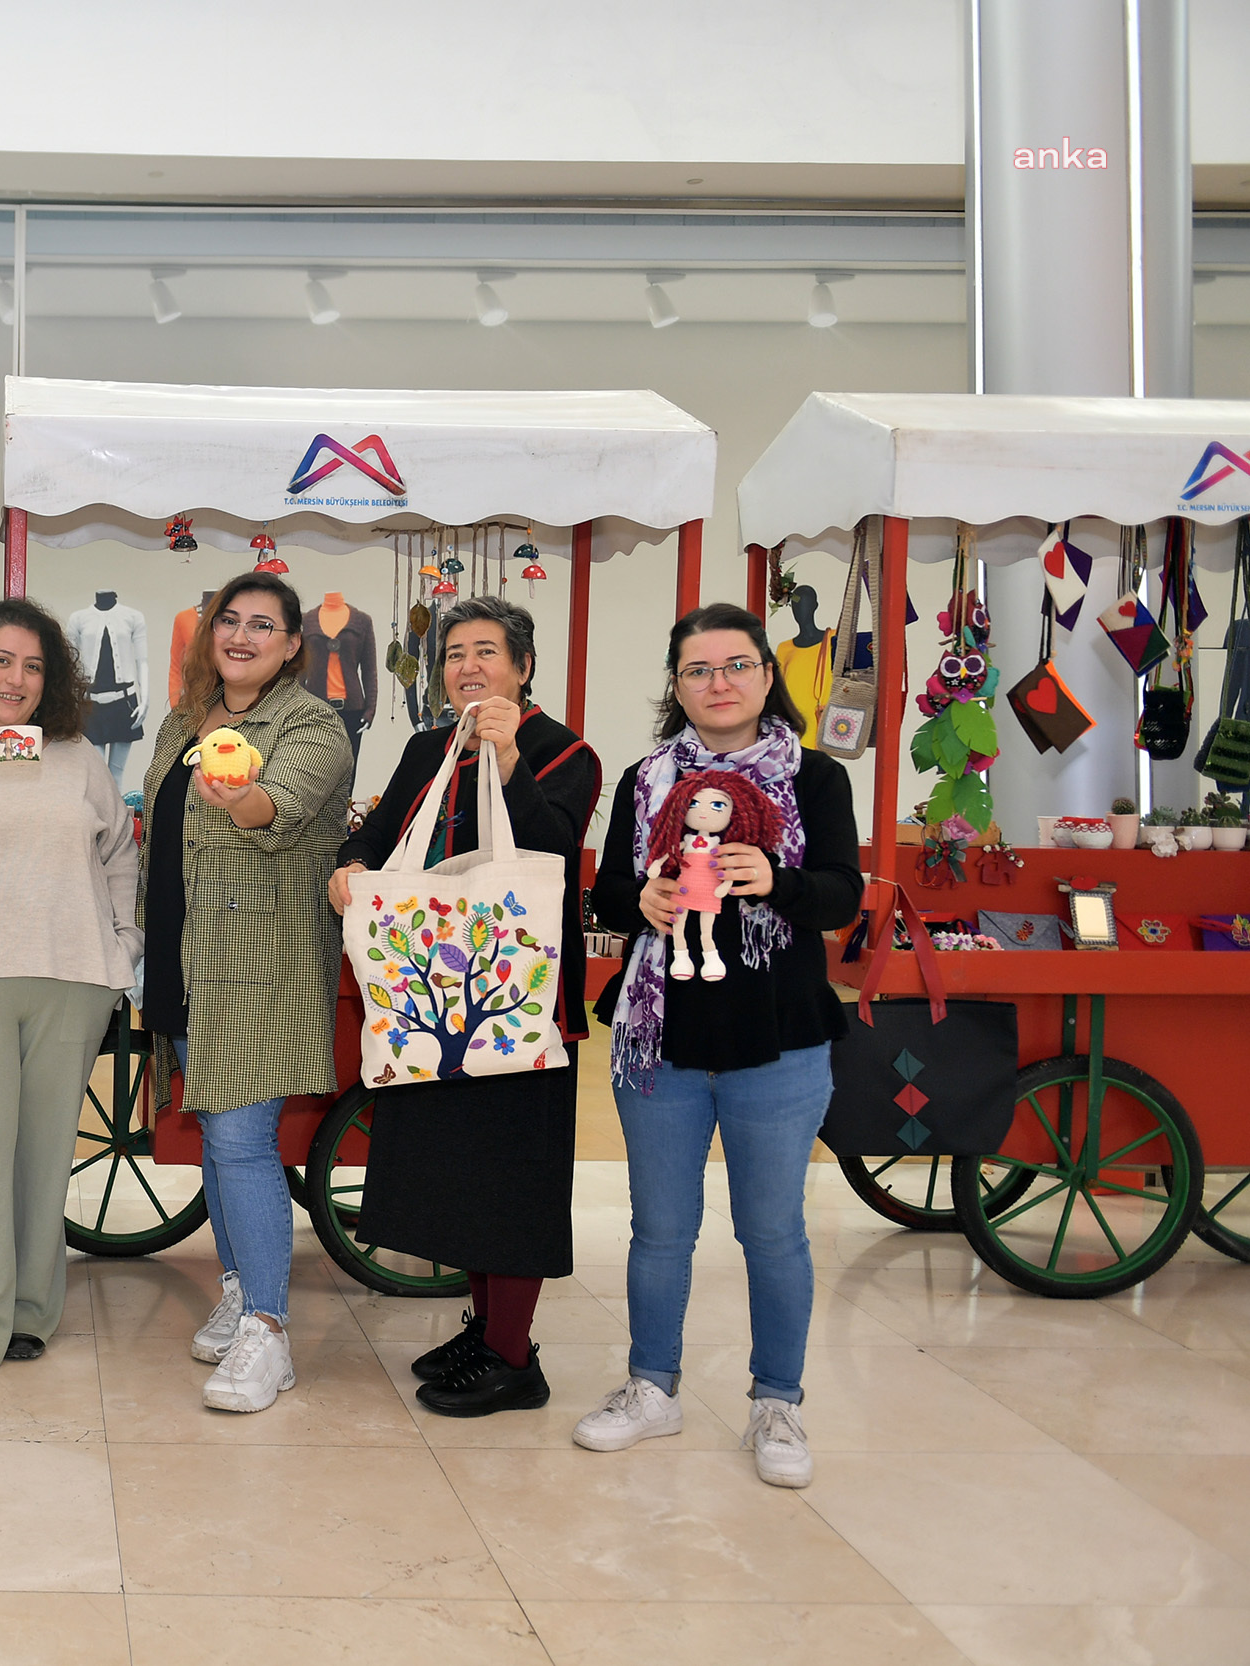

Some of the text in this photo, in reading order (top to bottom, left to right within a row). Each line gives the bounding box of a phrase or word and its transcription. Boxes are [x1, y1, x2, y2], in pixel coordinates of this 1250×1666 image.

[297, 496, 324, 506] MERSİN
[326, 497, 370, 508] BÜYÜKŞEHİR
[282, 1368, 295, 1386] FIL
